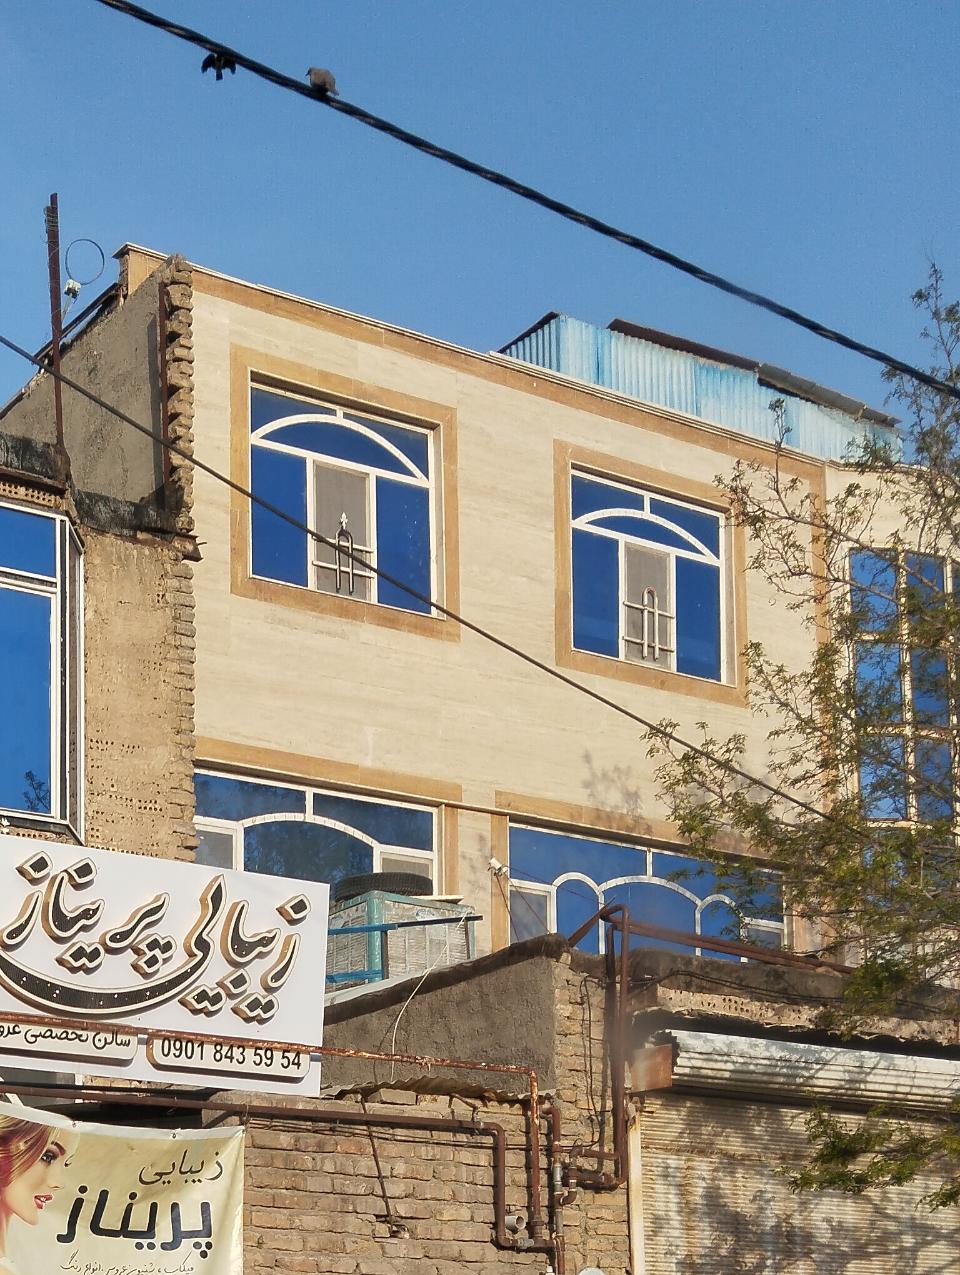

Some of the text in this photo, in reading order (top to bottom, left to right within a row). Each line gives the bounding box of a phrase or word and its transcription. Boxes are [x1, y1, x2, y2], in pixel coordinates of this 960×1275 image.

[92, 1030, 131, 1050] سالن
[161, 1037, 302, 1071] 0901 843 59 54
[139, 1149, 224, 1186] زیبایی
[56, 1184, 214, 1259] پریناز
[60, 1248, 82, 1273] رنگ
